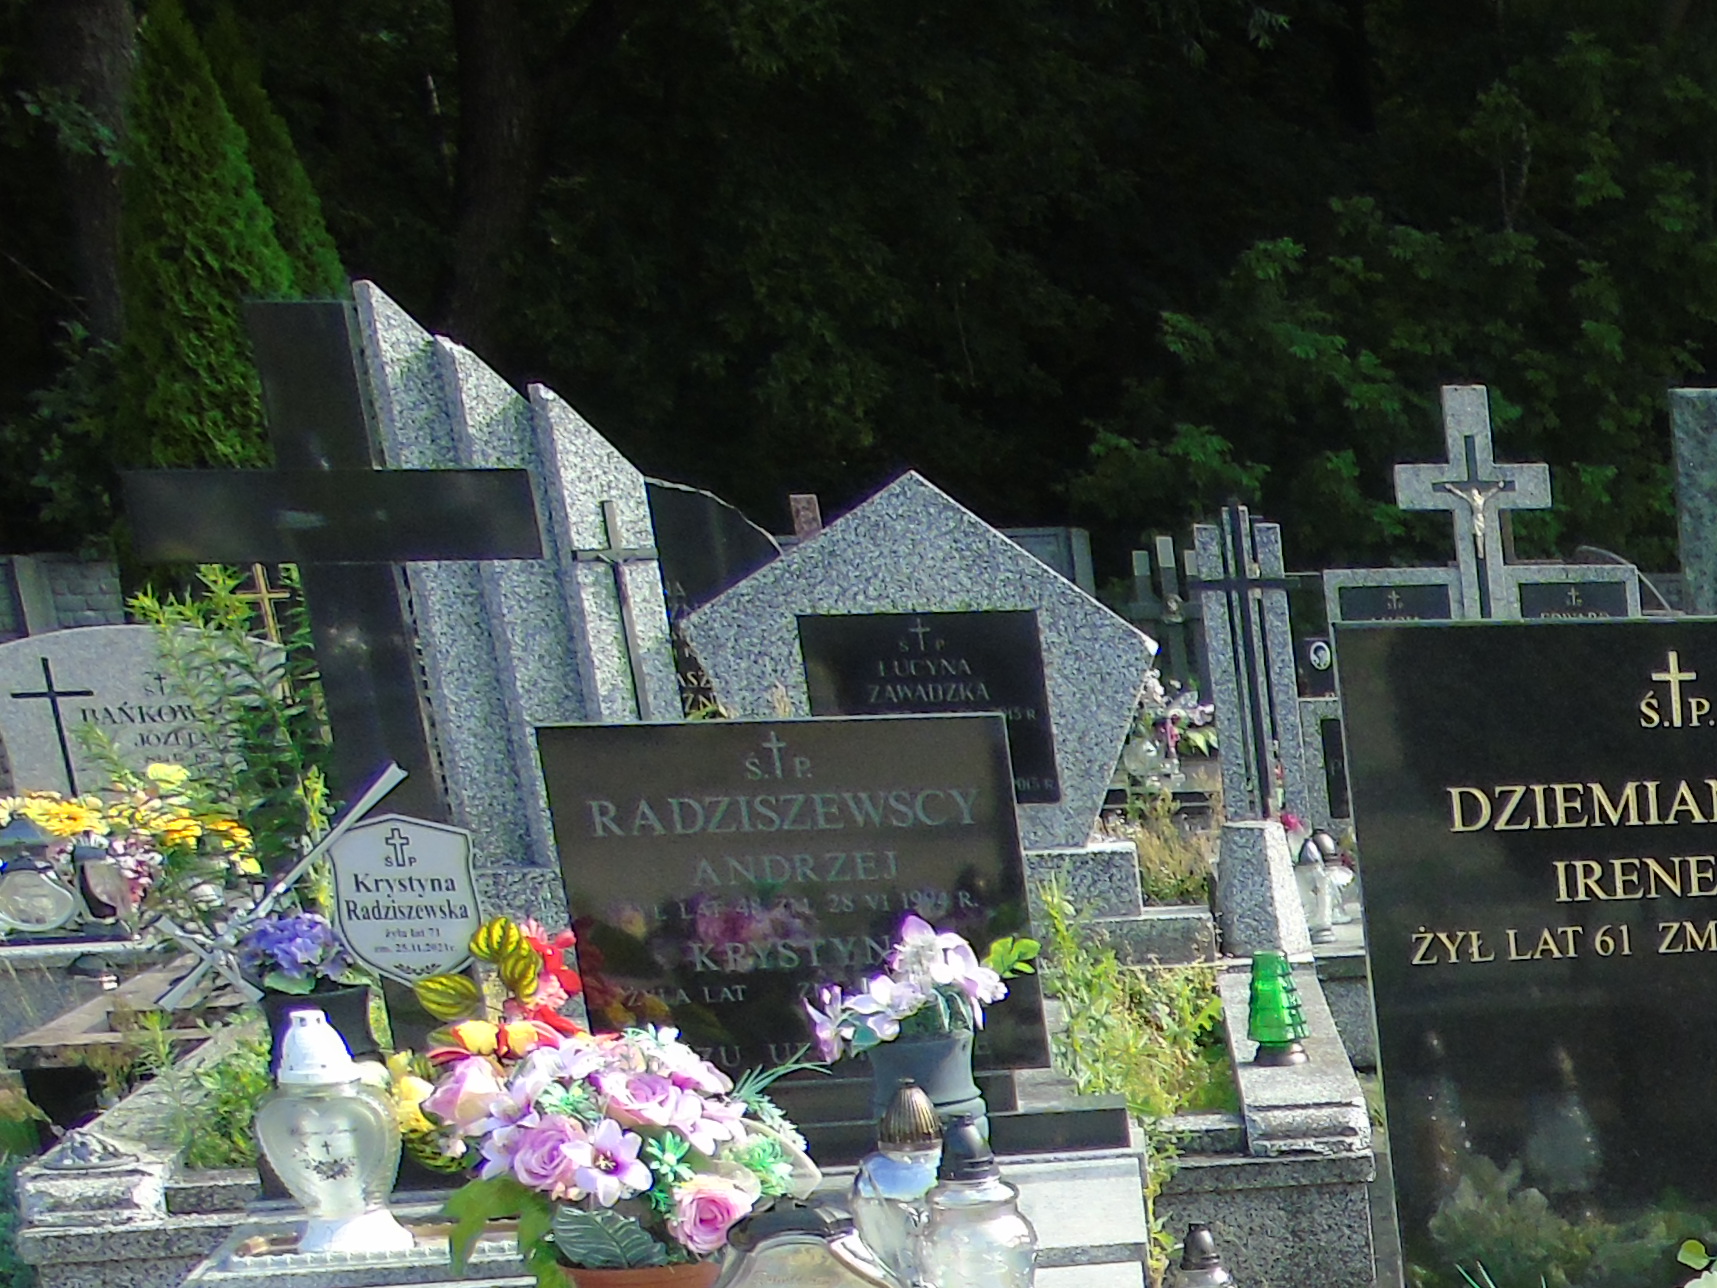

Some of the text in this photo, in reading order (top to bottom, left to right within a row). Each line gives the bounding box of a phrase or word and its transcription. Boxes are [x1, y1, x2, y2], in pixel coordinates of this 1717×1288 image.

[867, 682, 992, 704] ZAWADZKA
[81, 701, 200, 724] BAŃKOW
[1639, 691, 1716, 729] Ś. P.
[585, 788, 980, 838] RADZISZEWSCY
[693, 850, 898, 887] ANDRZEJ
[353, 873, 457, 898] Krystyna
[344, 898, 469, 921] Radziszewska
[688, 933, 893, 974] KRYSTYN
[1410, 925, 1494, 966] ŻYŁ
[1506, 926, 1584, 960] LAT
[1594, 925, 1633, 957] 61
[703, 984, 747, 1002] LAT
